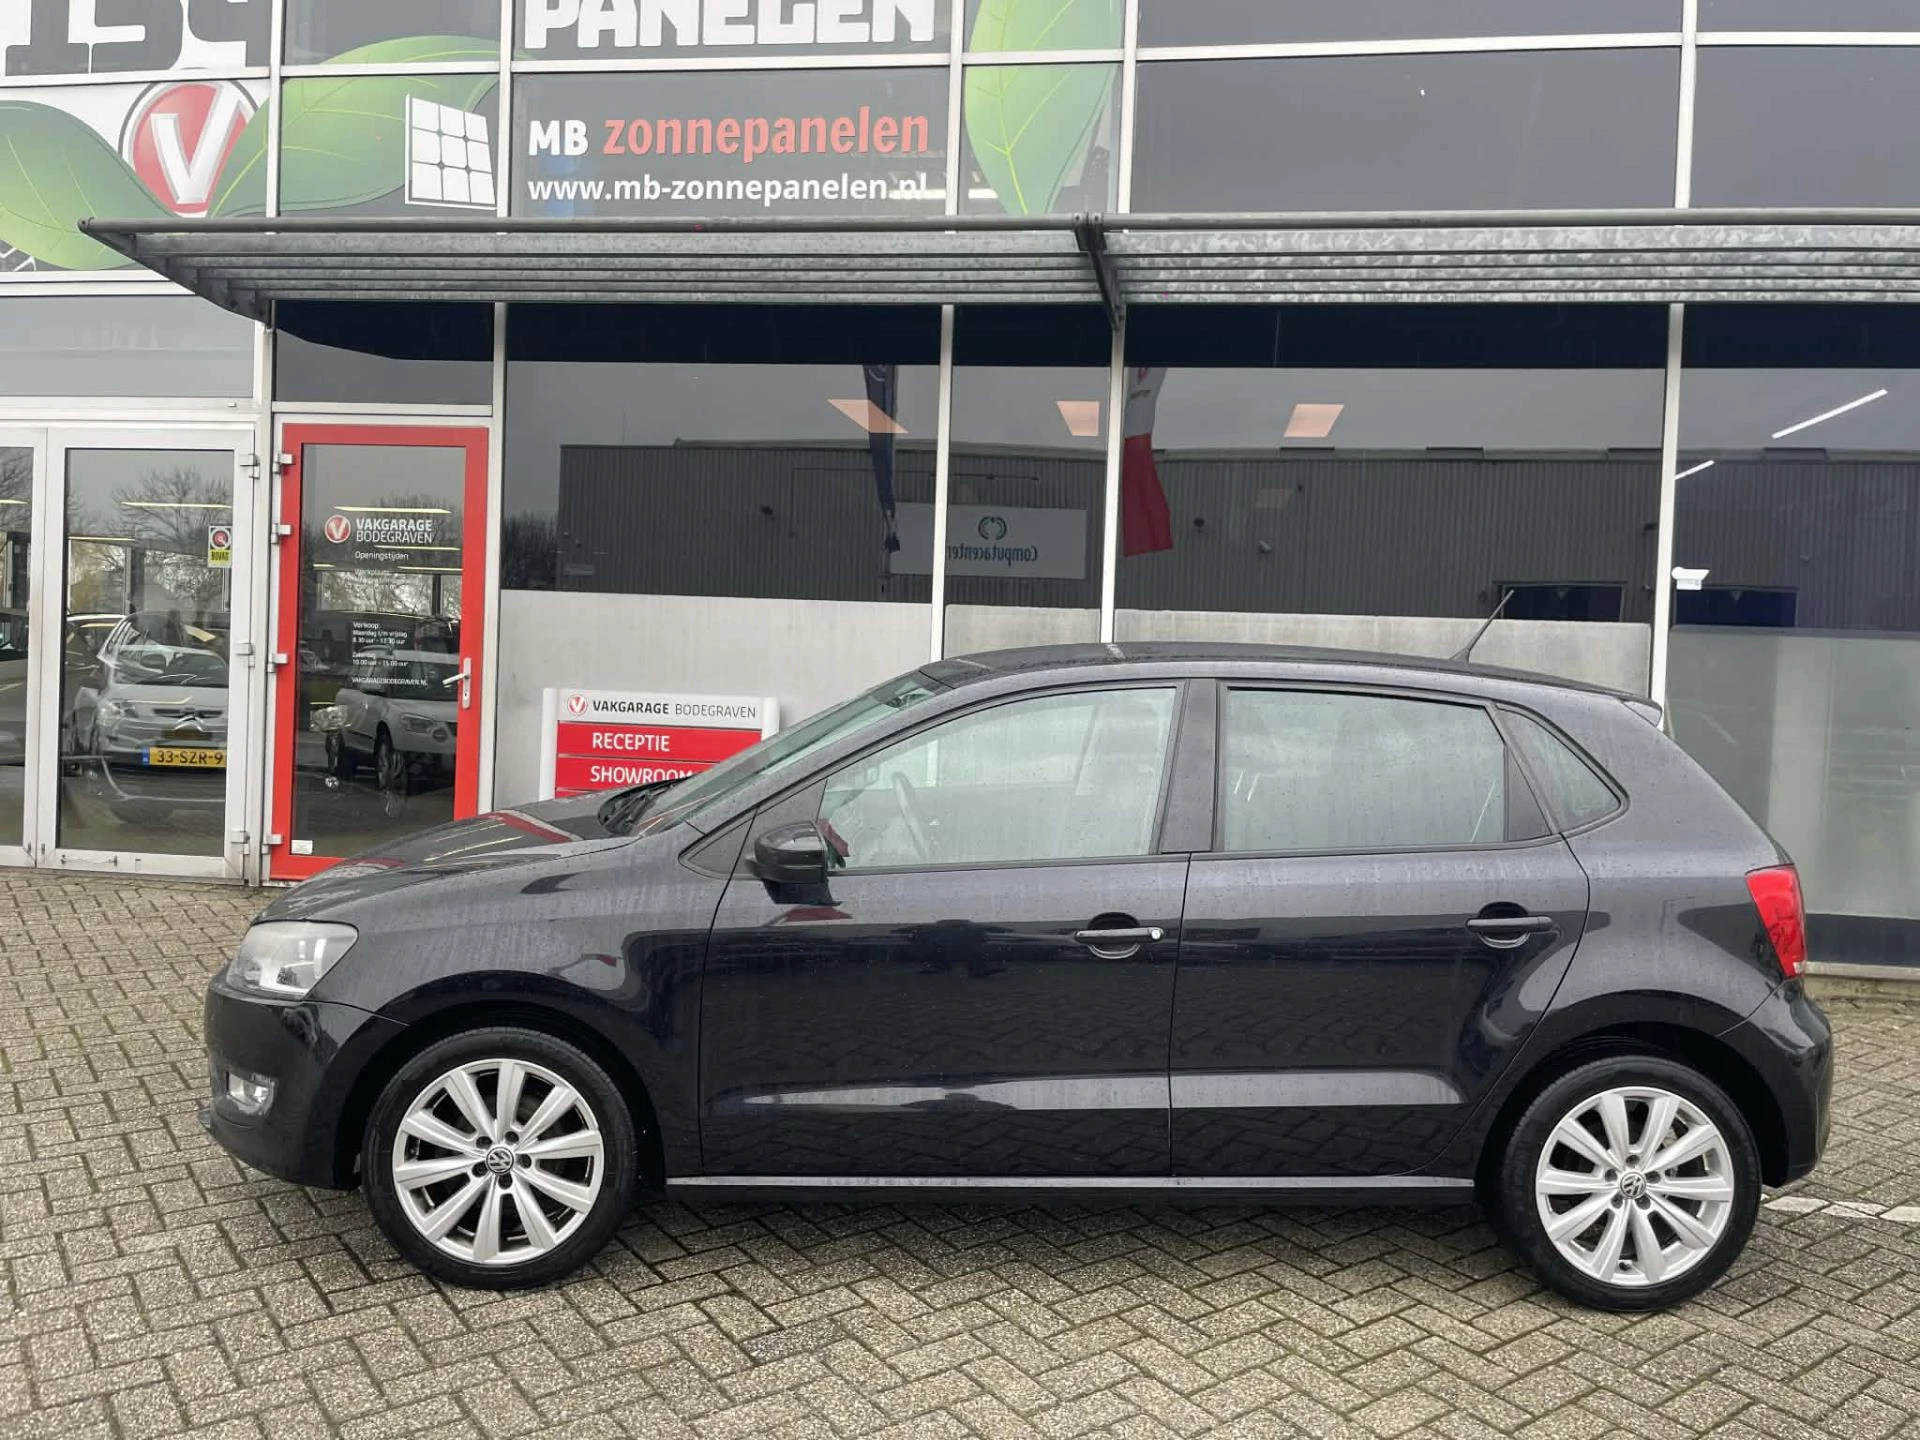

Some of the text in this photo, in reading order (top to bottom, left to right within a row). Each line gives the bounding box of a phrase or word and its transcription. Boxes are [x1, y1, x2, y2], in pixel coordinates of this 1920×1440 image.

[528, 105, 928, 164] MB zonnepanelen
[528, 173, 926, 207] www.mb-zonnepanelen.nl
[356, 518, 432, 532] VAKGARAGE
[356, 530, 432, 544] BODEGRAVEN
[354, 550, 409, 562] Openingstijden
[593, 700, 670, 715] VAKGARAGE
[675, 703, 757, 719] BODEGRAVEN
[592, 732, 670, 752] RECEPTIE
[157, 750, 223, 764] 33-SZR-9
